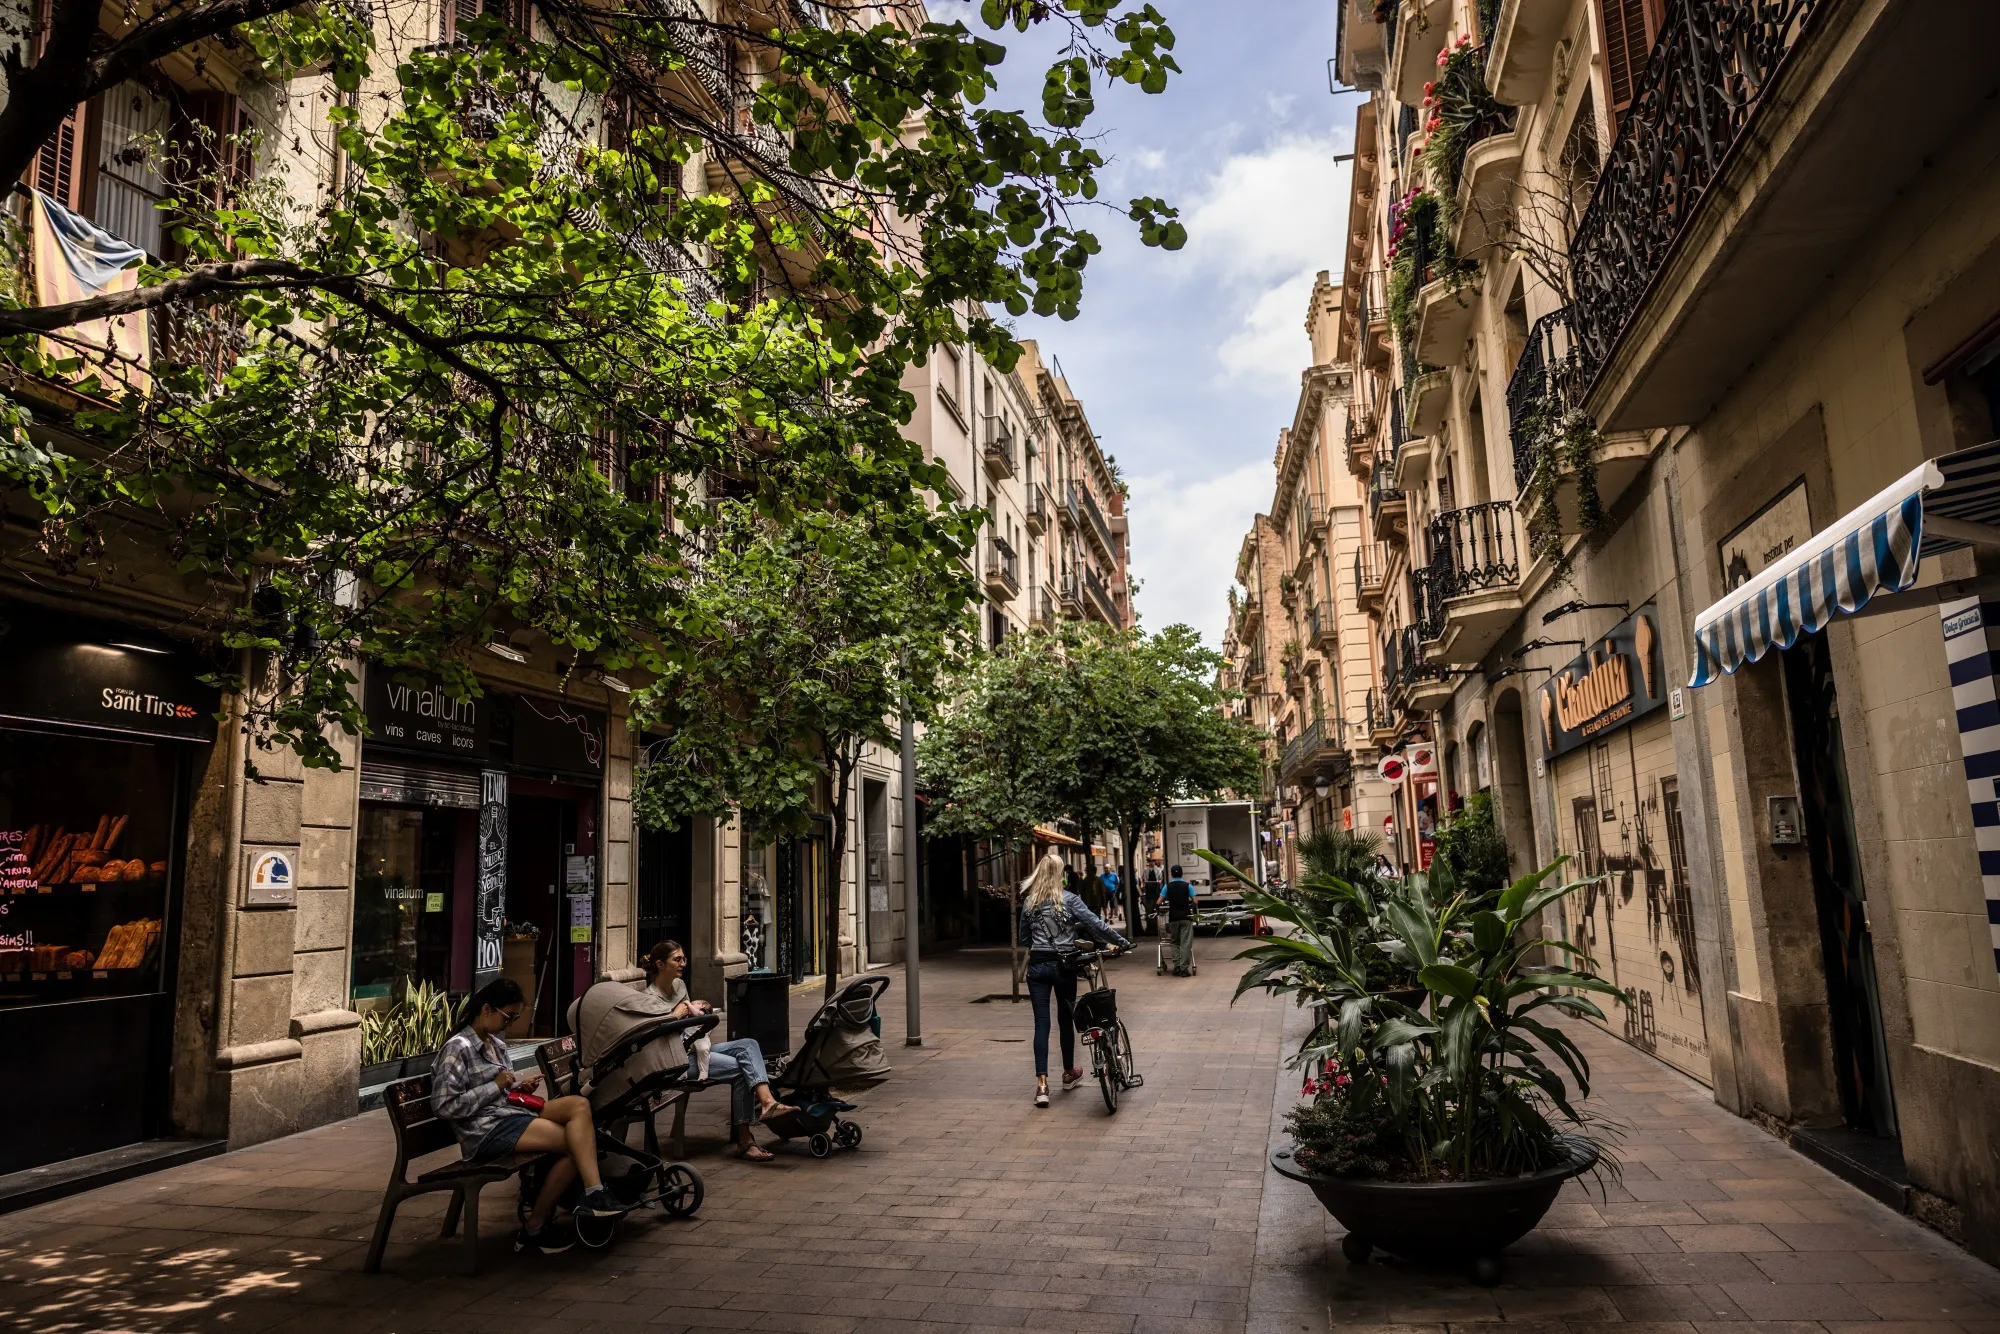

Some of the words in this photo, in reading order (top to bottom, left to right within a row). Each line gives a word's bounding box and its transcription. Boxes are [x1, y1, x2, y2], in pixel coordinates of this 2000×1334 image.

[101, 687, 142, 713] Sant
[144, 694, 175, 717] Tirs
[385, 723, 404, 737] vins
[416, 730, 442, 744] caves
[452, 733, 474, 749] licors
[384, 885, 424, 899] vinalium
